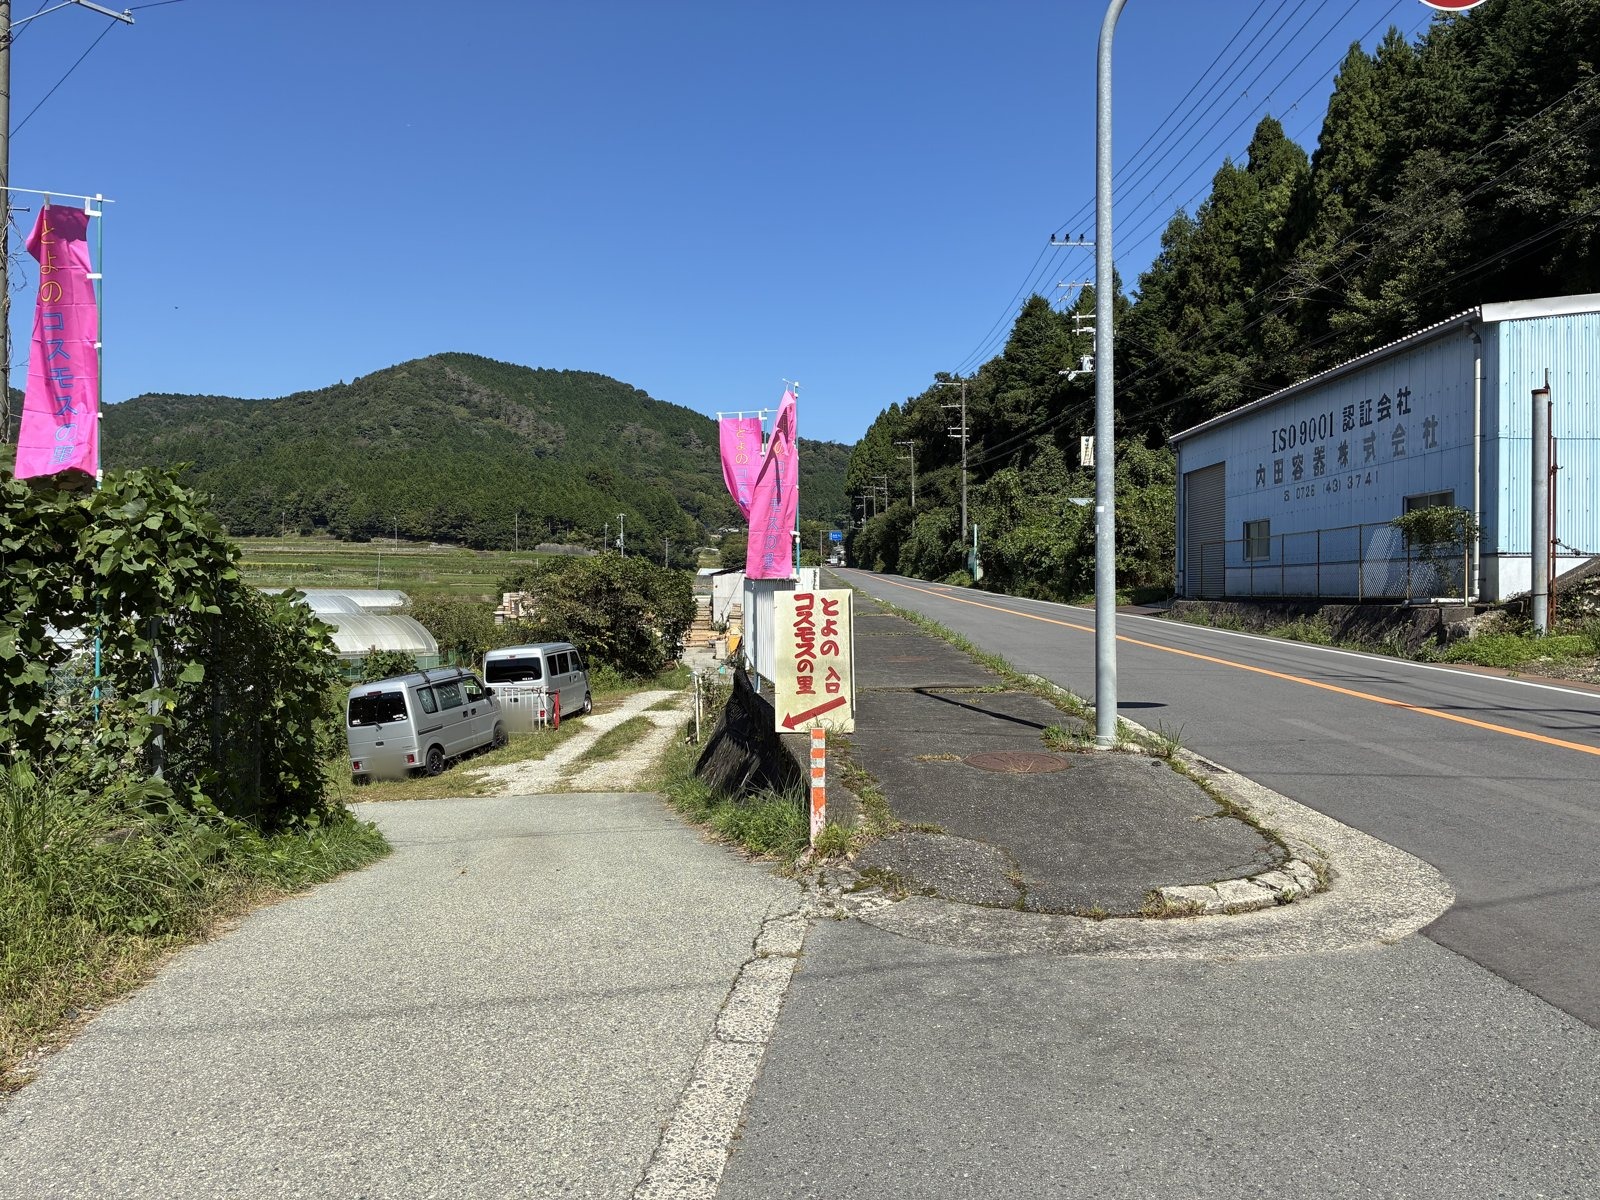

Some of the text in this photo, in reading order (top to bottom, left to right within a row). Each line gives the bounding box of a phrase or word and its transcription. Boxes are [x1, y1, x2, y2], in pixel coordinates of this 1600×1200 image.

[1255, 414, 1440, 489] 内田容器株式会社
[1271, 385, 1412, 454] ISO9001 認証会社
[793, 592, 817, 695] コスモスの里
[820, 597, 841, 694] とよの 入口
